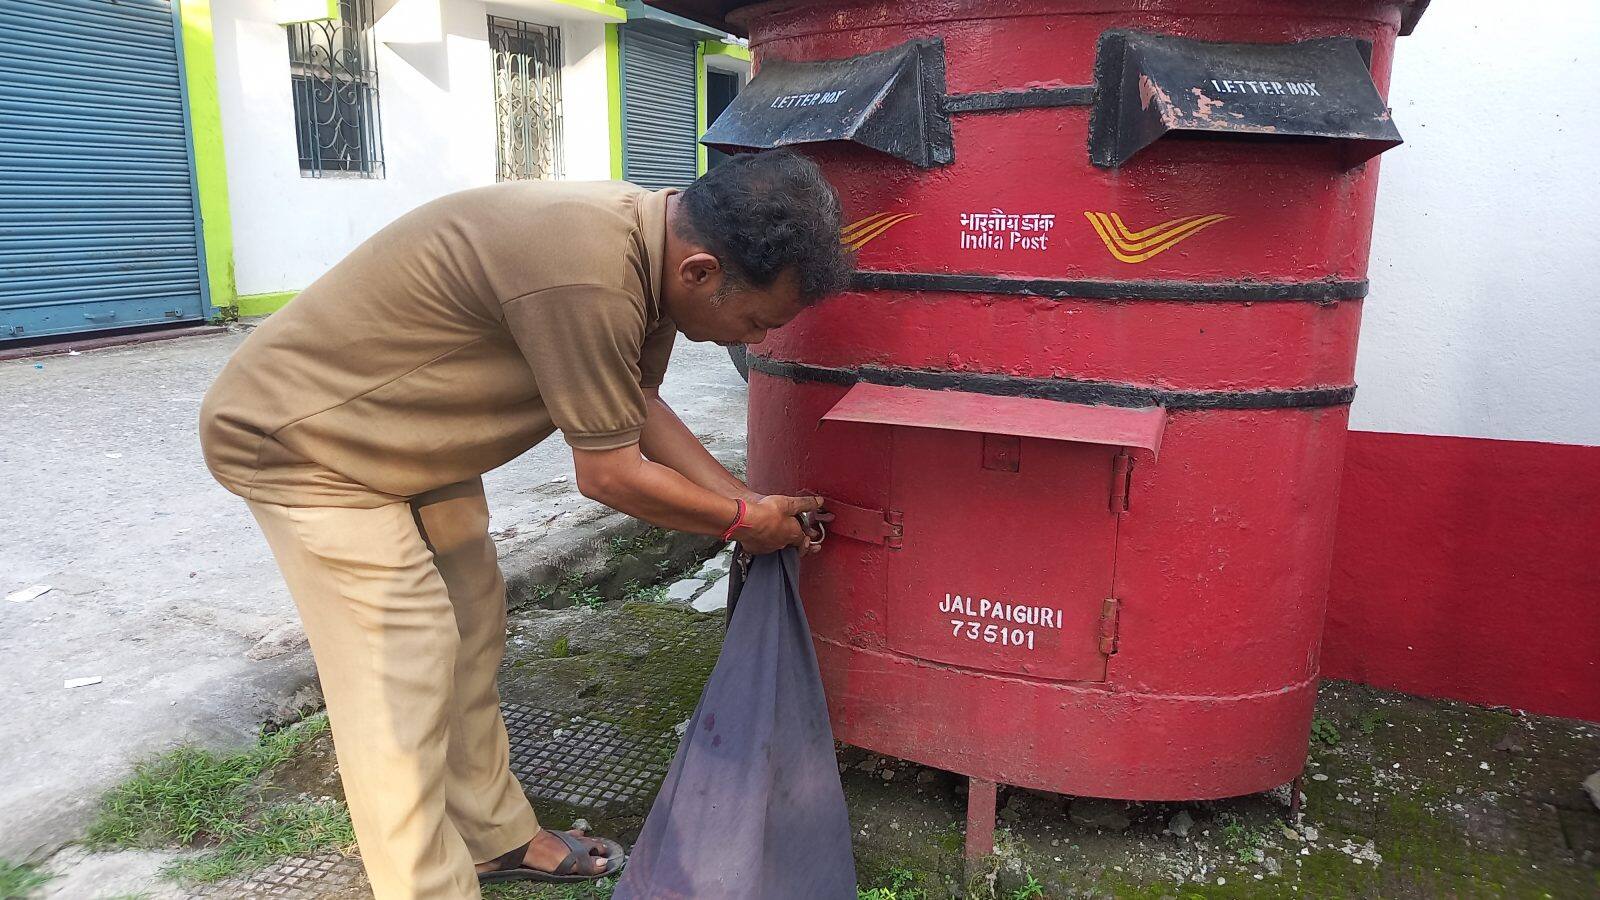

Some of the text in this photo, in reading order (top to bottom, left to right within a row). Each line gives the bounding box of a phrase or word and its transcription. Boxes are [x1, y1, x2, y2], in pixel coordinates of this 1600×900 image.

[1210, 79, 1321, 97] LETTER BOX
[770, 89, 847, 109] LETTER BOX
[960, 231, 1049, 251] India Post
[939, 593, 1063, 629] JALPAIGURI
[950, 619, 1034, 650] 735101
